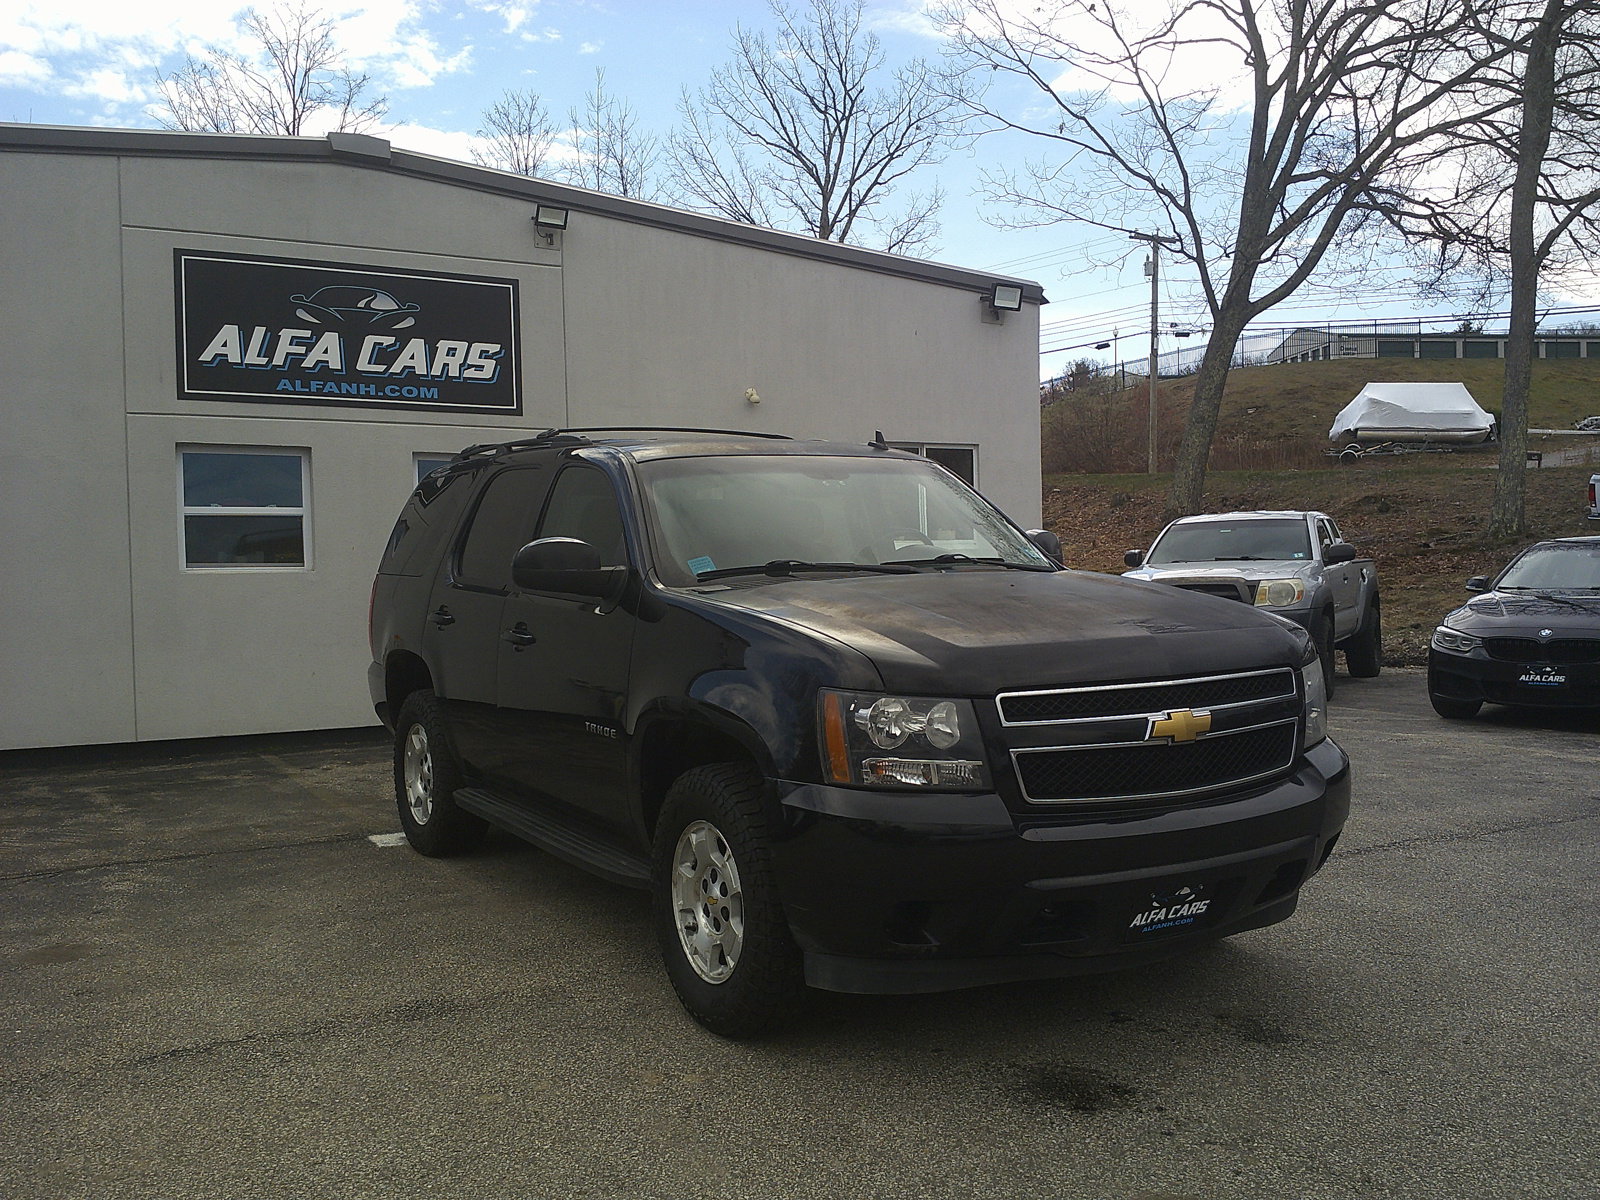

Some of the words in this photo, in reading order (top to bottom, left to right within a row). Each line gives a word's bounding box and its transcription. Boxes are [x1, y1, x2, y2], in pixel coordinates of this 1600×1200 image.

[198, 324, 346, 375] ALFA
[356, 334, 504, 384] CARS
[276, 378, 439, 399] ALFANH.COM
[1519, 674, 1540, 682] ALFA
[585, 721, 617, 739] TAHOE
[1129, 907, 1167, 928] ALFA
[1167, 899, 1211, 919] CARS
[1141, 917, 1194, 933] ALFANH.COM
